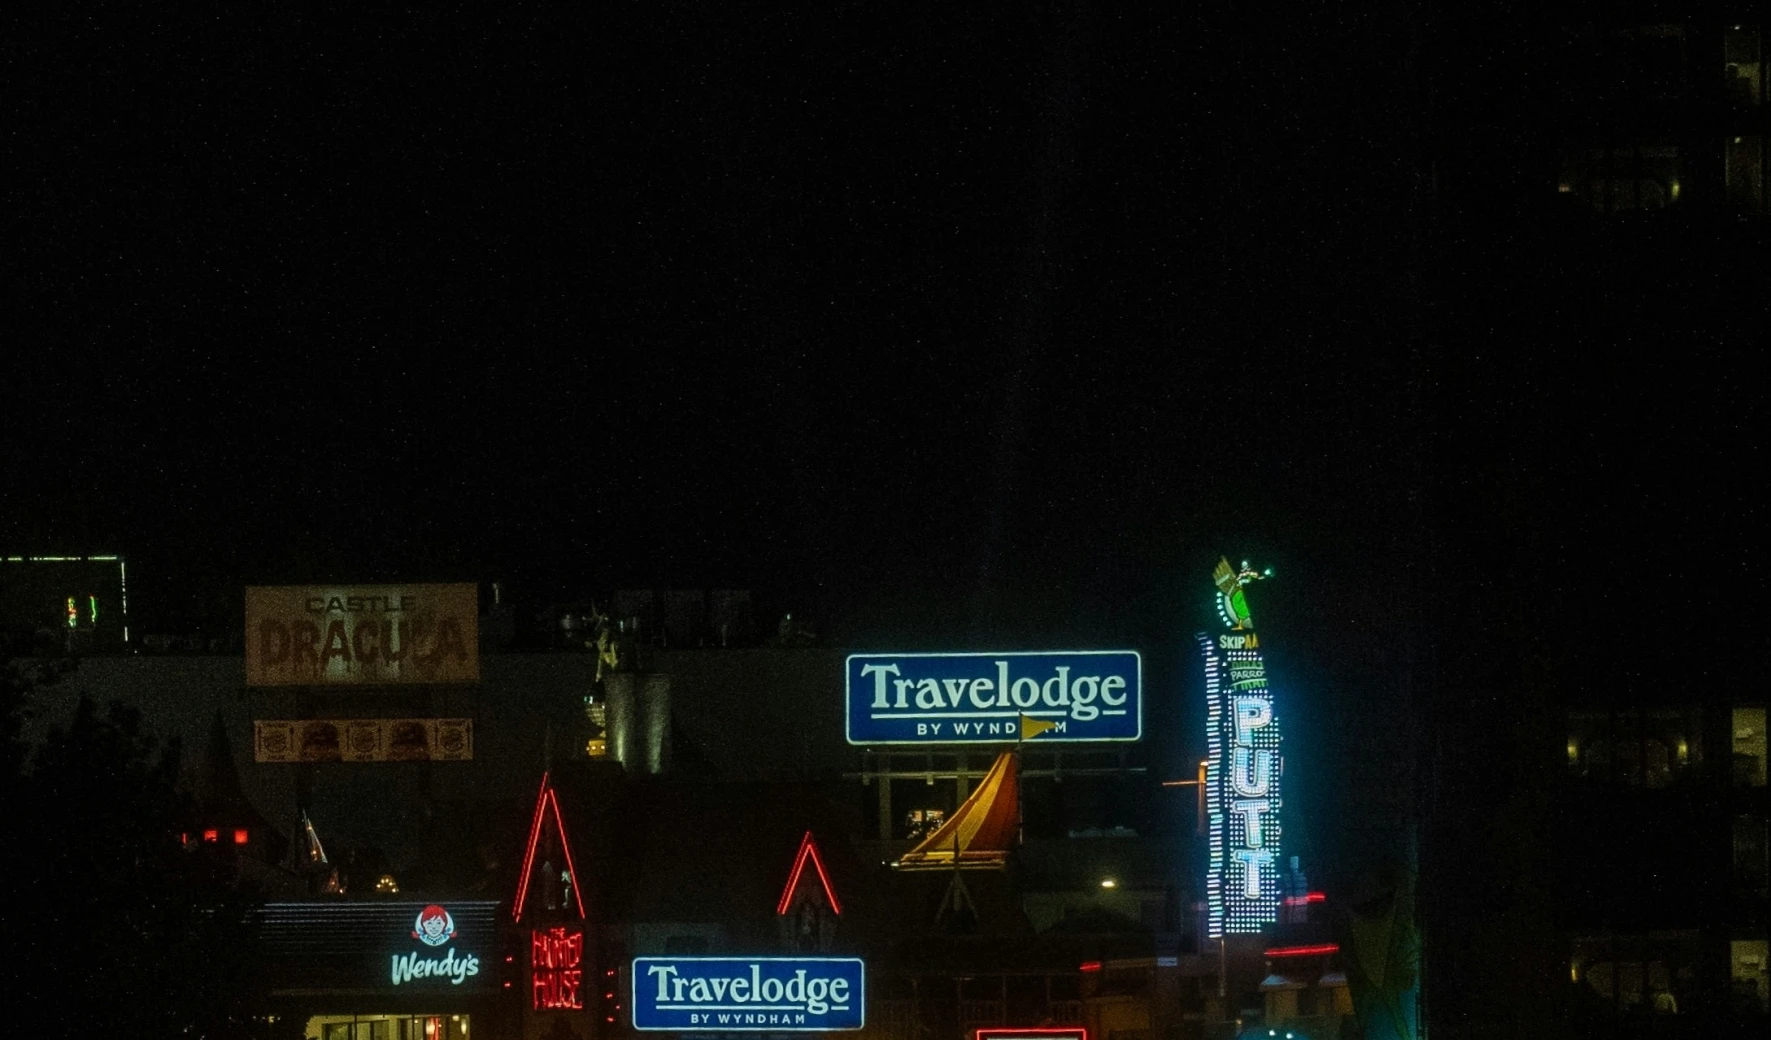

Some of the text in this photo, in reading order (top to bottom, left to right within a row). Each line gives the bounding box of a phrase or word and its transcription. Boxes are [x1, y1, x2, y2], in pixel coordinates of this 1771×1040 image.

[304, 596, 416, 613] CASTLE
[860, 660, 1127, 721] Travelodge
[917, 721, 1067, 736] BY WYNDM
[1232, 698, 1273, 899] PUTT
[391, 948, 479, 985] Wendy's
[647, 964, 850, 1015] Travelodge
[690, 1013, 806, 1025] BY WYNDHAM
